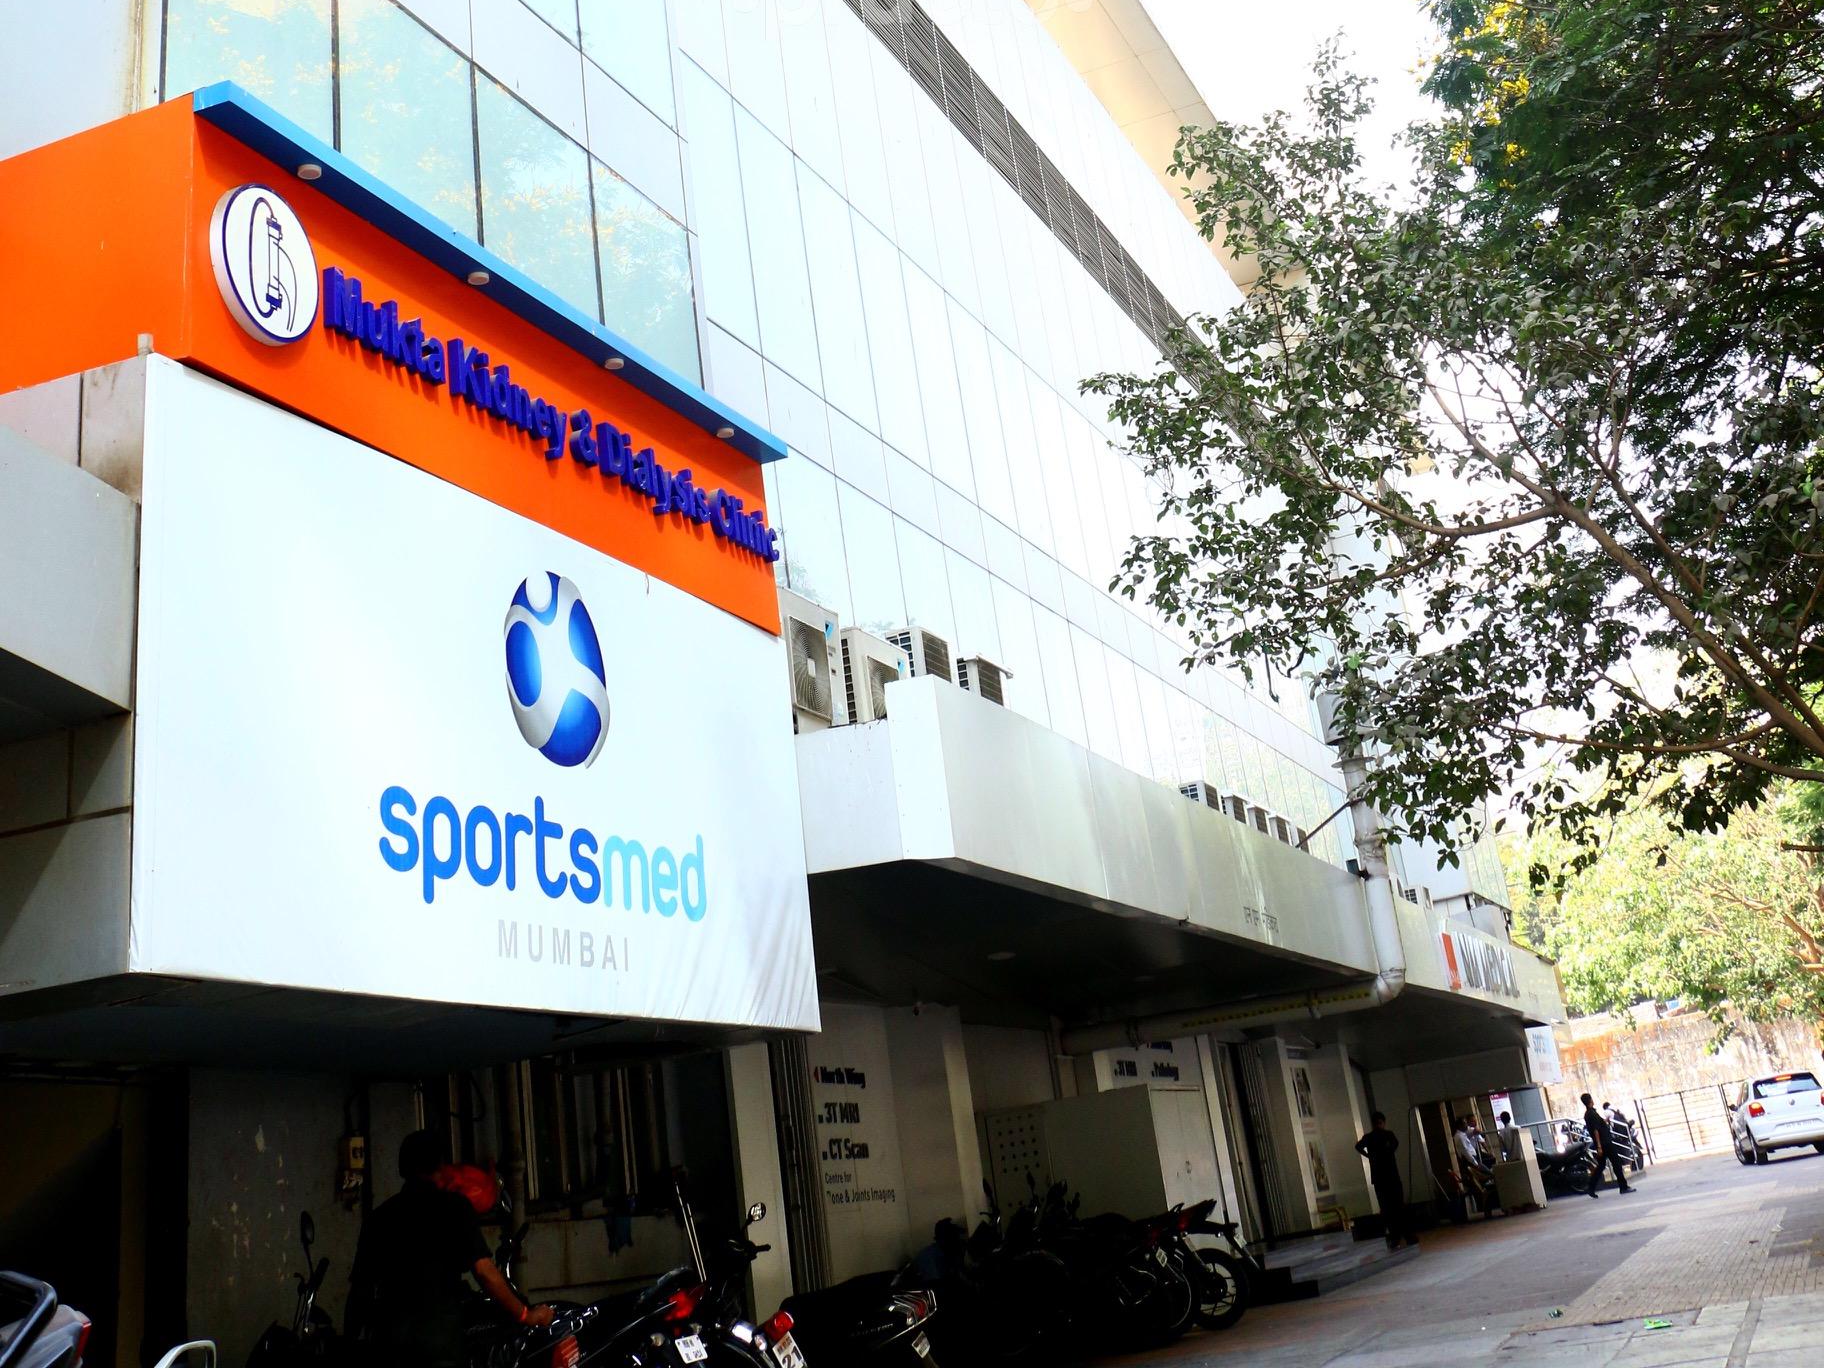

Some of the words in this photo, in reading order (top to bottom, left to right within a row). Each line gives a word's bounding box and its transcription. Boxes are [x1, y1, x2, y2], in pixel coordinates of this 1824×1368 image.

[323, 266, 445, 385] Mukta
[448, 338, 567, 460] Kidney
[569, 409, 598, 467] &
[596, 422, 711, 524] Dialysis
[709, 488, 779, 563] Clinic
[379, 785, 707, 922] sportsmed
[497, 919, 629, 972] MUMBAI
[826, 1190, 844, 1205] one
